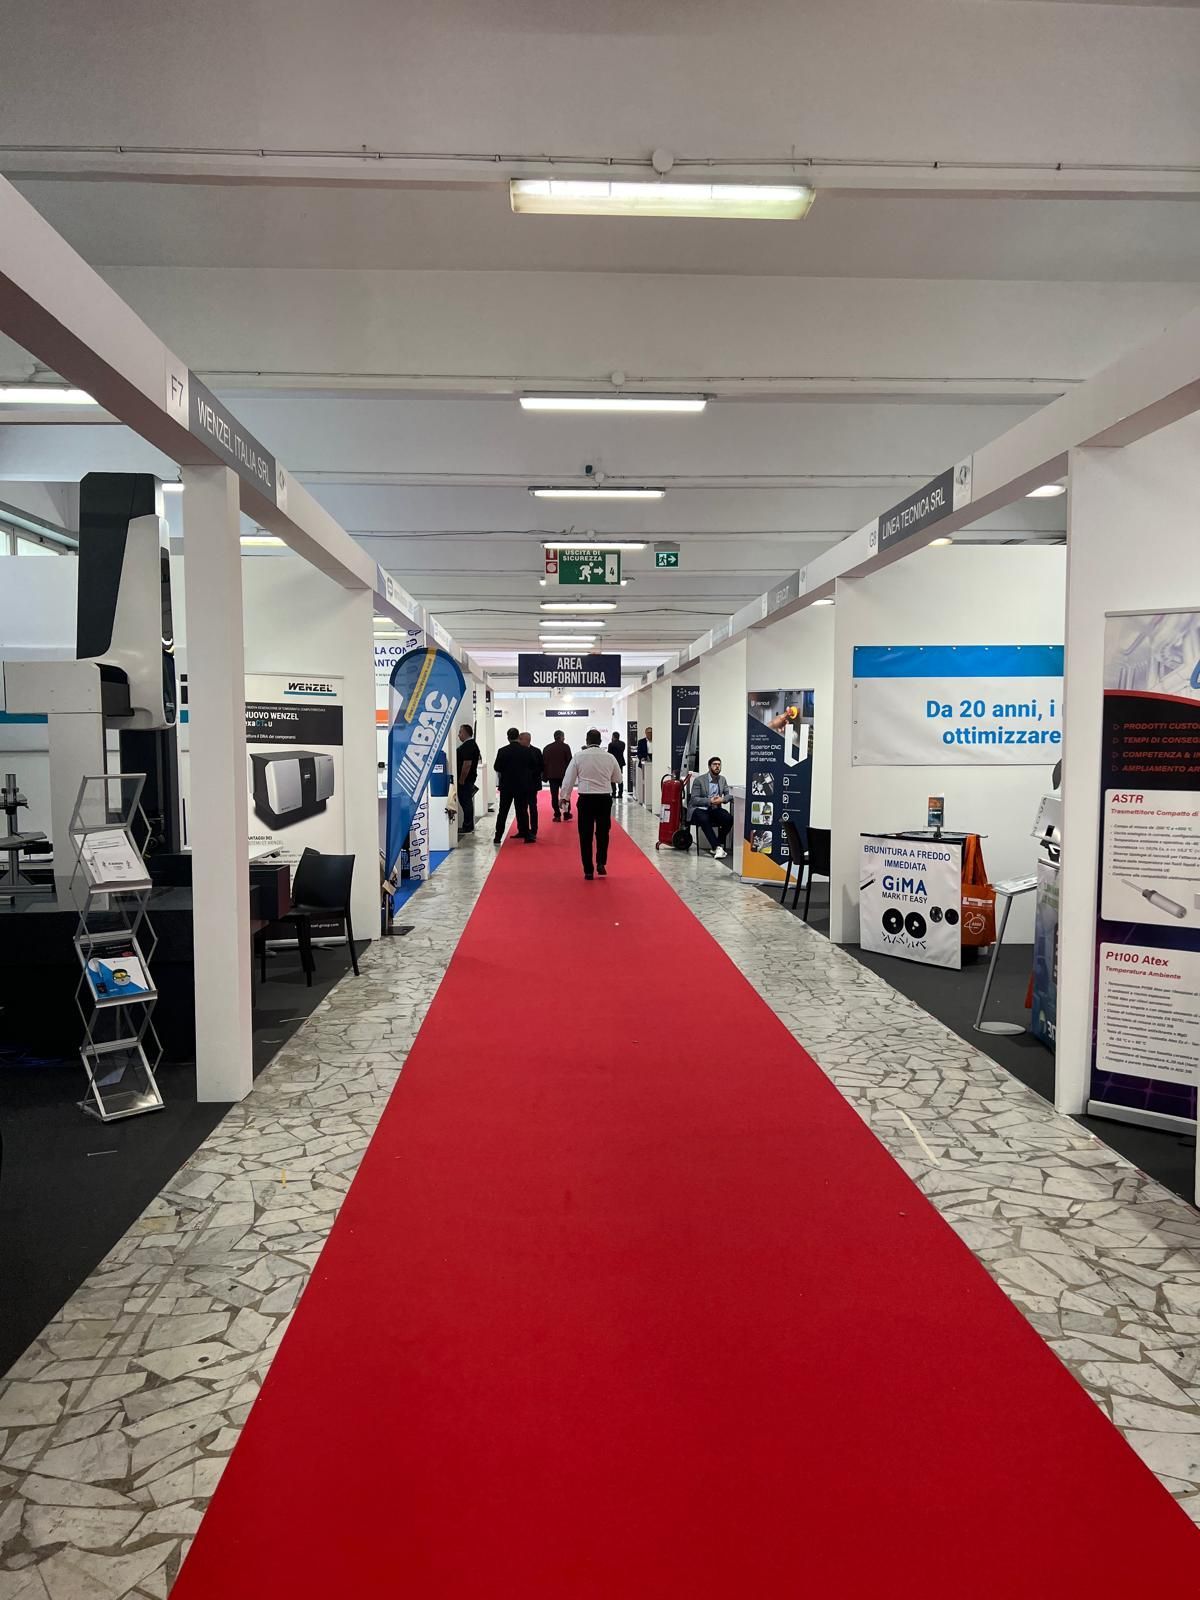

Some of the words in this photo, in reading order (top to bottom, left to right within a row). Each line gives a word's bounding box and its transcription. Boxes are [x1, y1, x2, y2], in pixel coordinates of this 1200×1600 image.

[171, 374, 184, 407] F7
[197, 397, 234, 453] WENZEL
[234, 434, 258, 472] ITALIA
[257, 457, 272, 488] SRL
[882, 516, 901, 540] LINEA
[900, 497, 930, 529] TECNICA
[930, 487, 946, 511] SRL
[609, 567, 615, 576] 4
[557, 657, 583, 670] AREA
[533, 671, 606, 684] SUBFORNITURA
[288, 682, 333, 692] WENZEL
[270, 712, 299, 720] WENZEL
[926, 700, 953, 718] Da
[959, 699, 986, 718] 20
[992, 699, 1043, 721] anni,
[1049, 699, 1055, 717] i
[405, 690, 449, 771] ABAC
[1168, 722, 1200, 730] CUSTO
[942, 726, 1062, 744] ottimizzare
[1111, 794, 1144, 804] ASTR
[1111, 808, 1155, 816] Trasmettitore
[863, 845, 908, 857] BRUNITURA
[909, 847, 915, 857] A
[917, 849, 951, 862] FREDDO
[884, 859, 927, 872] IMMEDIATA
[882, 875, 928, 896] GiMA
[881, 891, 902, 901] MARK
[902, 893, 908, 901] IT
[909, 894, 928, 904] EASY
[1105, 951, 1139, 963] Pt100
[1142, 955, 1169, 967] Atex
[1105, 966, 1147, 976] Temperatura
[1148, 971, 1182, 980] Ambiente
